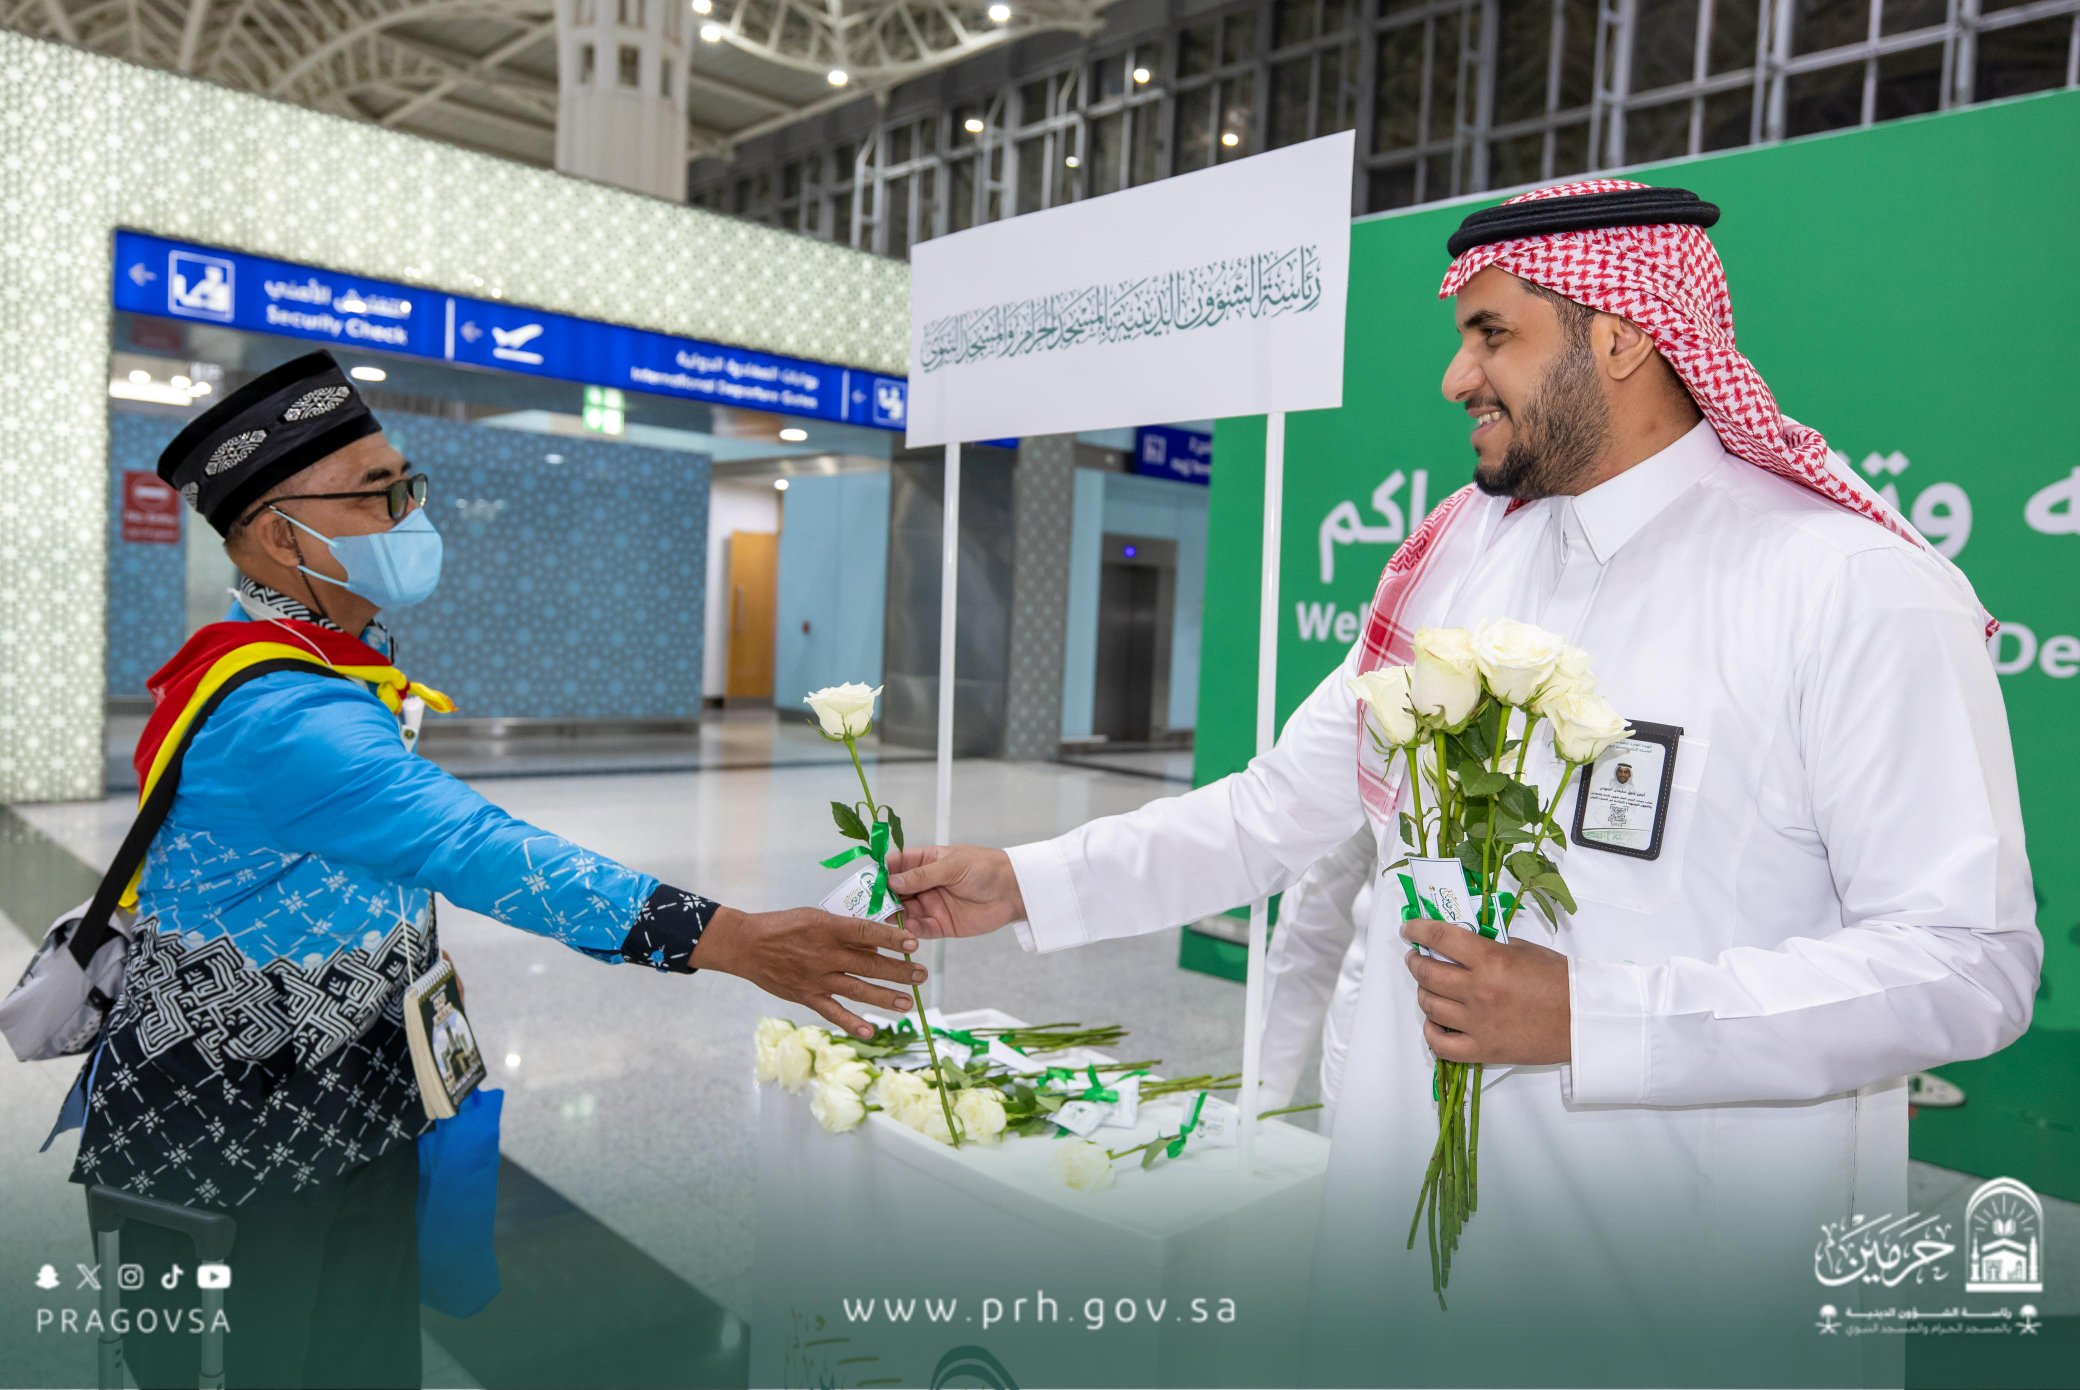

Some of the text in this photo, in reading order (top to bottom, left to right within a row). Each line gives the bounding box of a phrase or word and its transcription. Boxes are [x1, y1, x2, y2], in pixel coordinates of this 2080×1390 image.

[266, 304, 408, 346] Security Check
[630, 367, 715, 393] International
